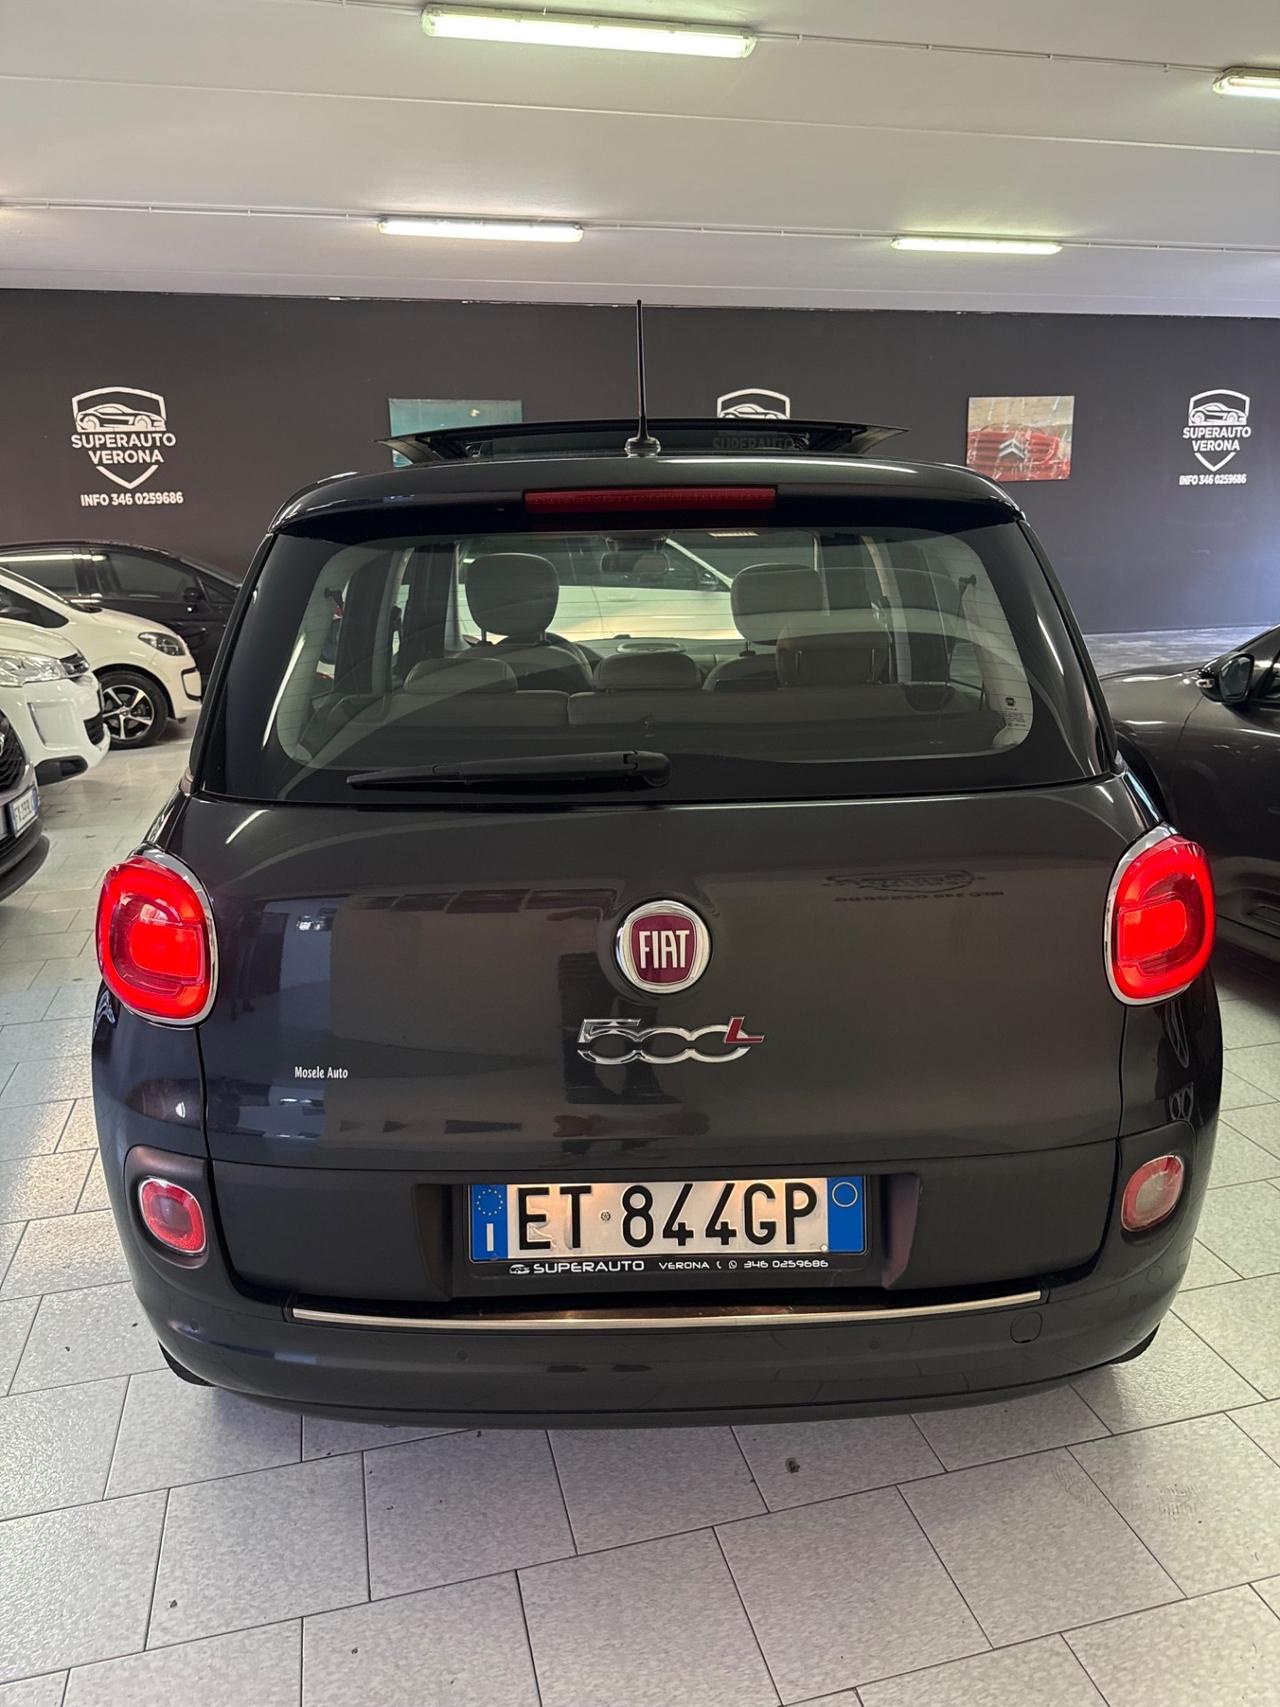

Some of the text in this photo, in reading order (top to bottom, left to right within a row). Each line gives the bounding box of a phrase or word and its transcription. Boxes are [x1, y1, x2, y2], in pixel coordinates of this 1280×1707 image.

[1182, 426, 1252, 439] SUPERAUTO
[71, 432, 176, 449] SUPERAUTO
[1192, 439, 1240, 451] VERONA
[88, 449, 164, 465] VERONA
[1179, 475, 1199, 485] INFO
[1199, 474, 1214, 485] 346
[80, 491, 184, 506] INFO 346 0259686
[639, 930, 690, 968] FIAT
[294, 1066, 349, 1078] Mosele Auto
[517, 1182, 818, 1250] ET 844GP
[533, 1259, 829, 1274] SUPERAUTO VERONA 346 0259686
